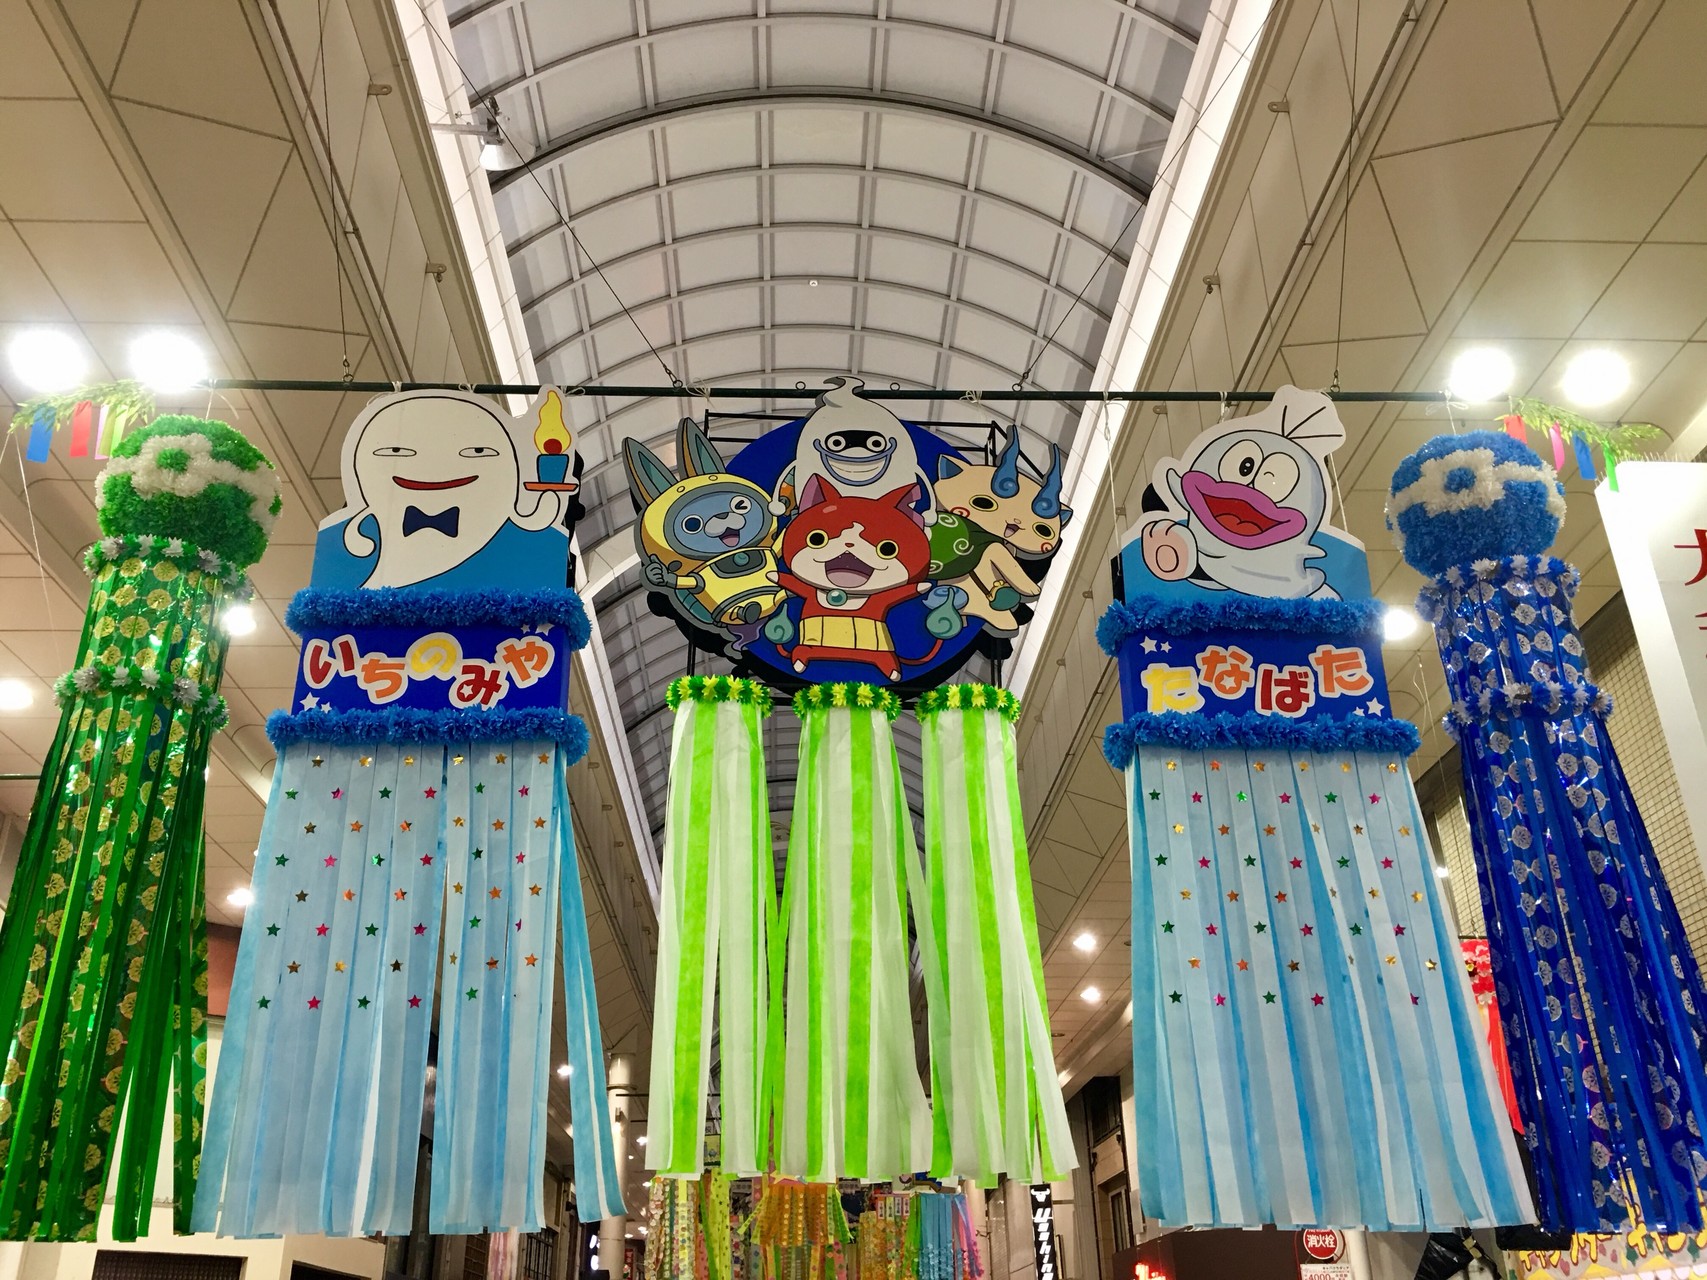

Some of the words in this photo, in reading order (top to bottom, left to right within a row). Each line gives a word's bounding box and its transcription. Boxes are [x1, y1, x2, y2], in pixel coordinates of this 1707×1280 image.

[306, 635, 551, 708] いちのみや
[1143, 647, 1371, 714] たなばた
[1306, 1234, 1336, 1248] 消火栓
